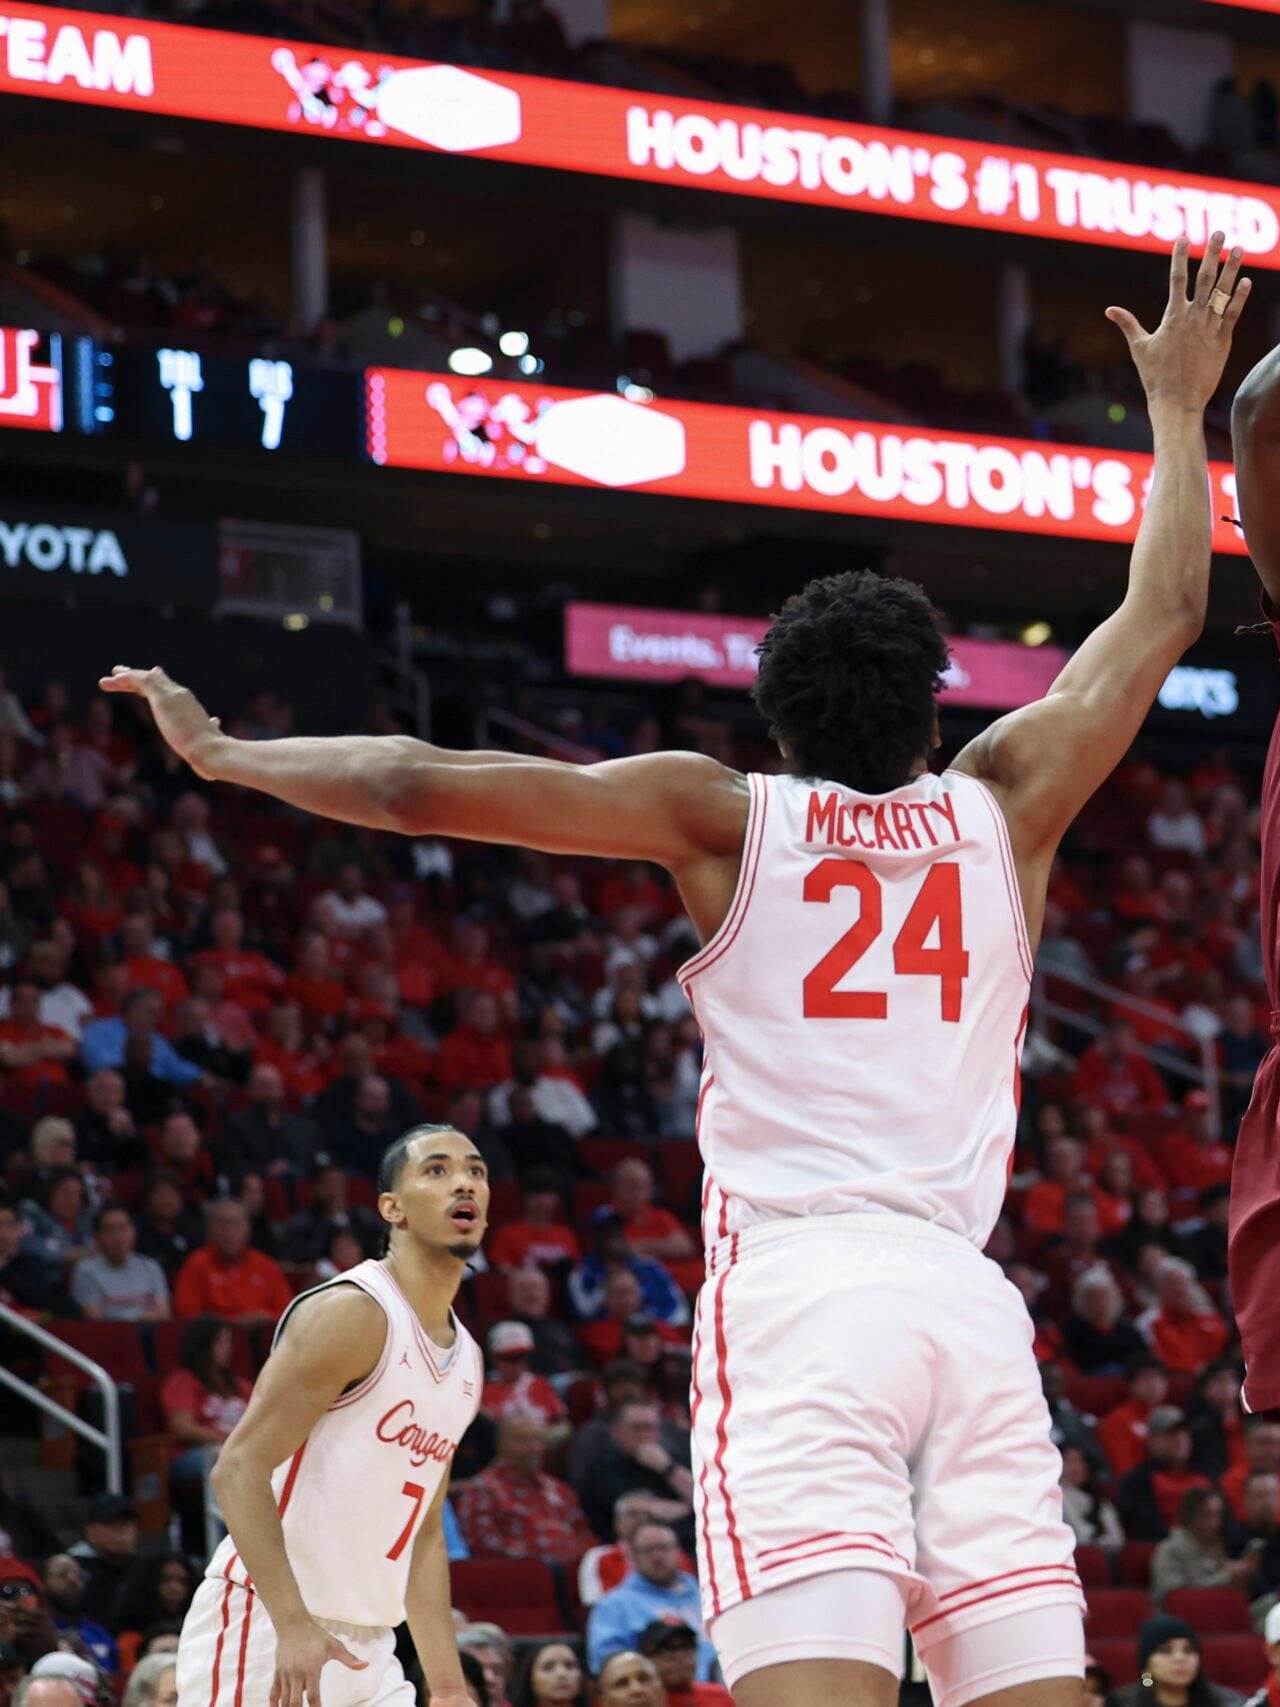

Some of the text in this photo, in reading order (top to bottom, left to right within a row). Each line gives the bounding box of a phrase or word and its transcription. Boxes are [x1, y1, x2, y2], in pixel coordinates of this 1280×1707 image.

[626, 105, 969, 210] HOUSTON'S
[974, 155, 1041, 221] #1
[1045, 167, 1279, 254] TRUSTED
[748, 420, 1135, 527] HOUSTON'S
[802, 858, 970, 1024] 24
[385, 1480, 426, 1561] 7
